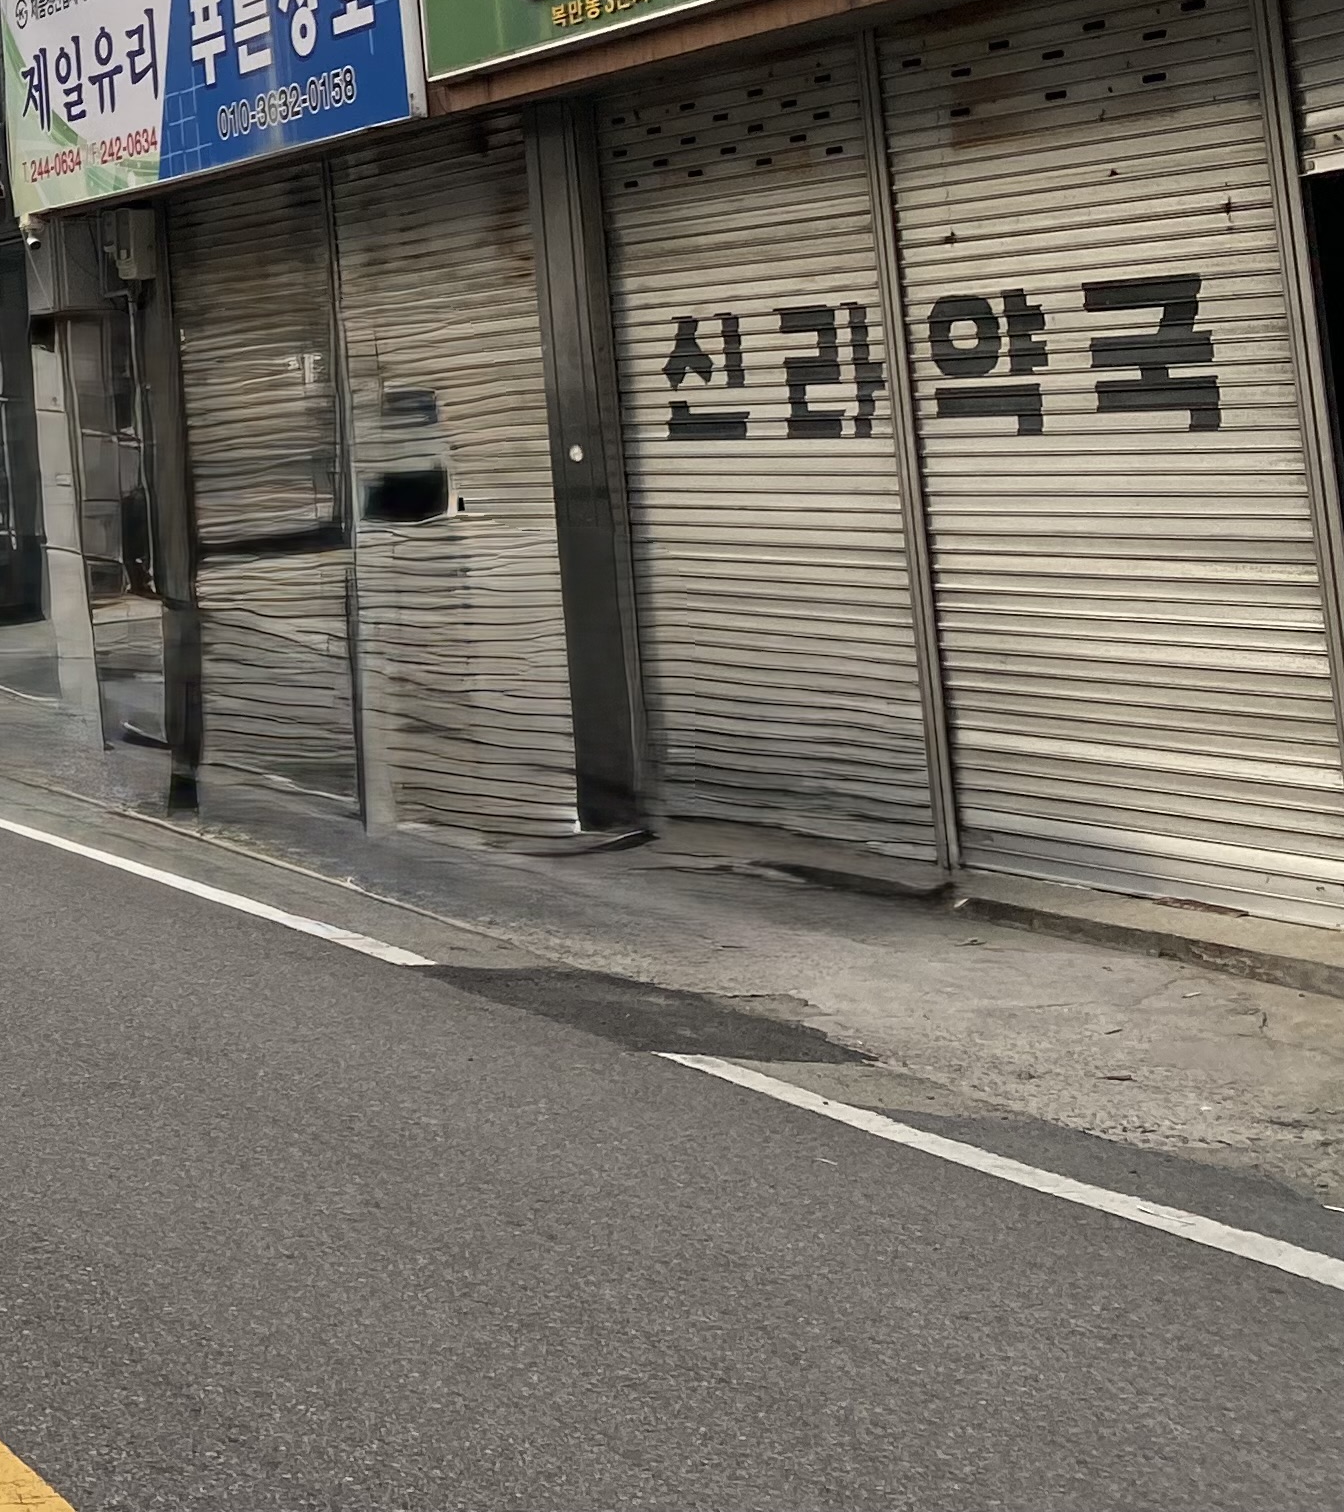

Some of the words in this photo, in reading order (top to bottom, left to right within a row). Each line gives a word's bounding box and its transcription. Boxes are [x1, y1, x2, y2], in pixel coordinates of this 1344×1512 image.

[21, 6, 159, 134] 제일유리
[216, 65, 357, 141] 010-3632-0158
[661, 271, 1222, 440] 신라약국
